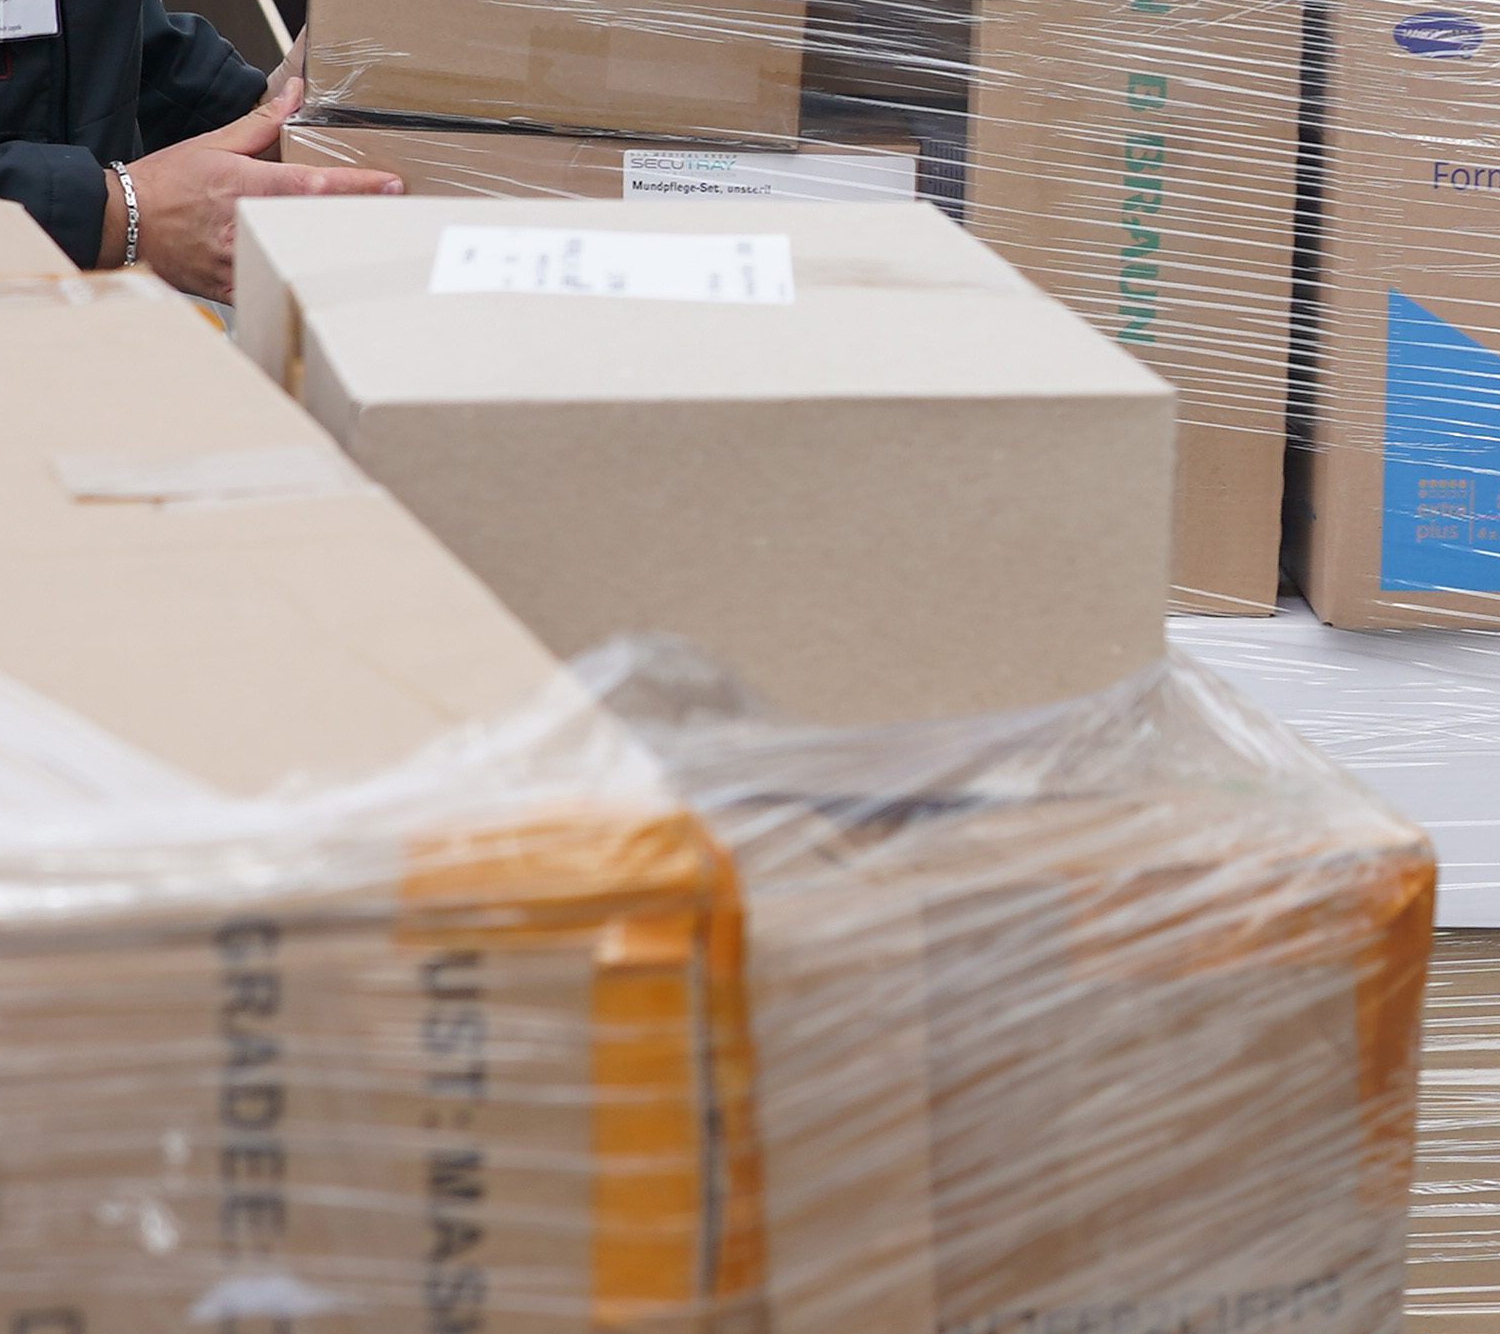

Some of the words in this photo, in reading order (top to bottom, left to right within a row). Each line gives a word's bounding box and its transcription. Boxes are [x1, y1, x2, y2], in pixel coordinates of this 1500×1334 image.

[630, 157, 736, 172] SECUTRAY
[632, 180, 724, 195] Mundpflege-Set,
[1116, 137, 1164, 346] BRAUN
[1416, 520, 1460, 544] plus
